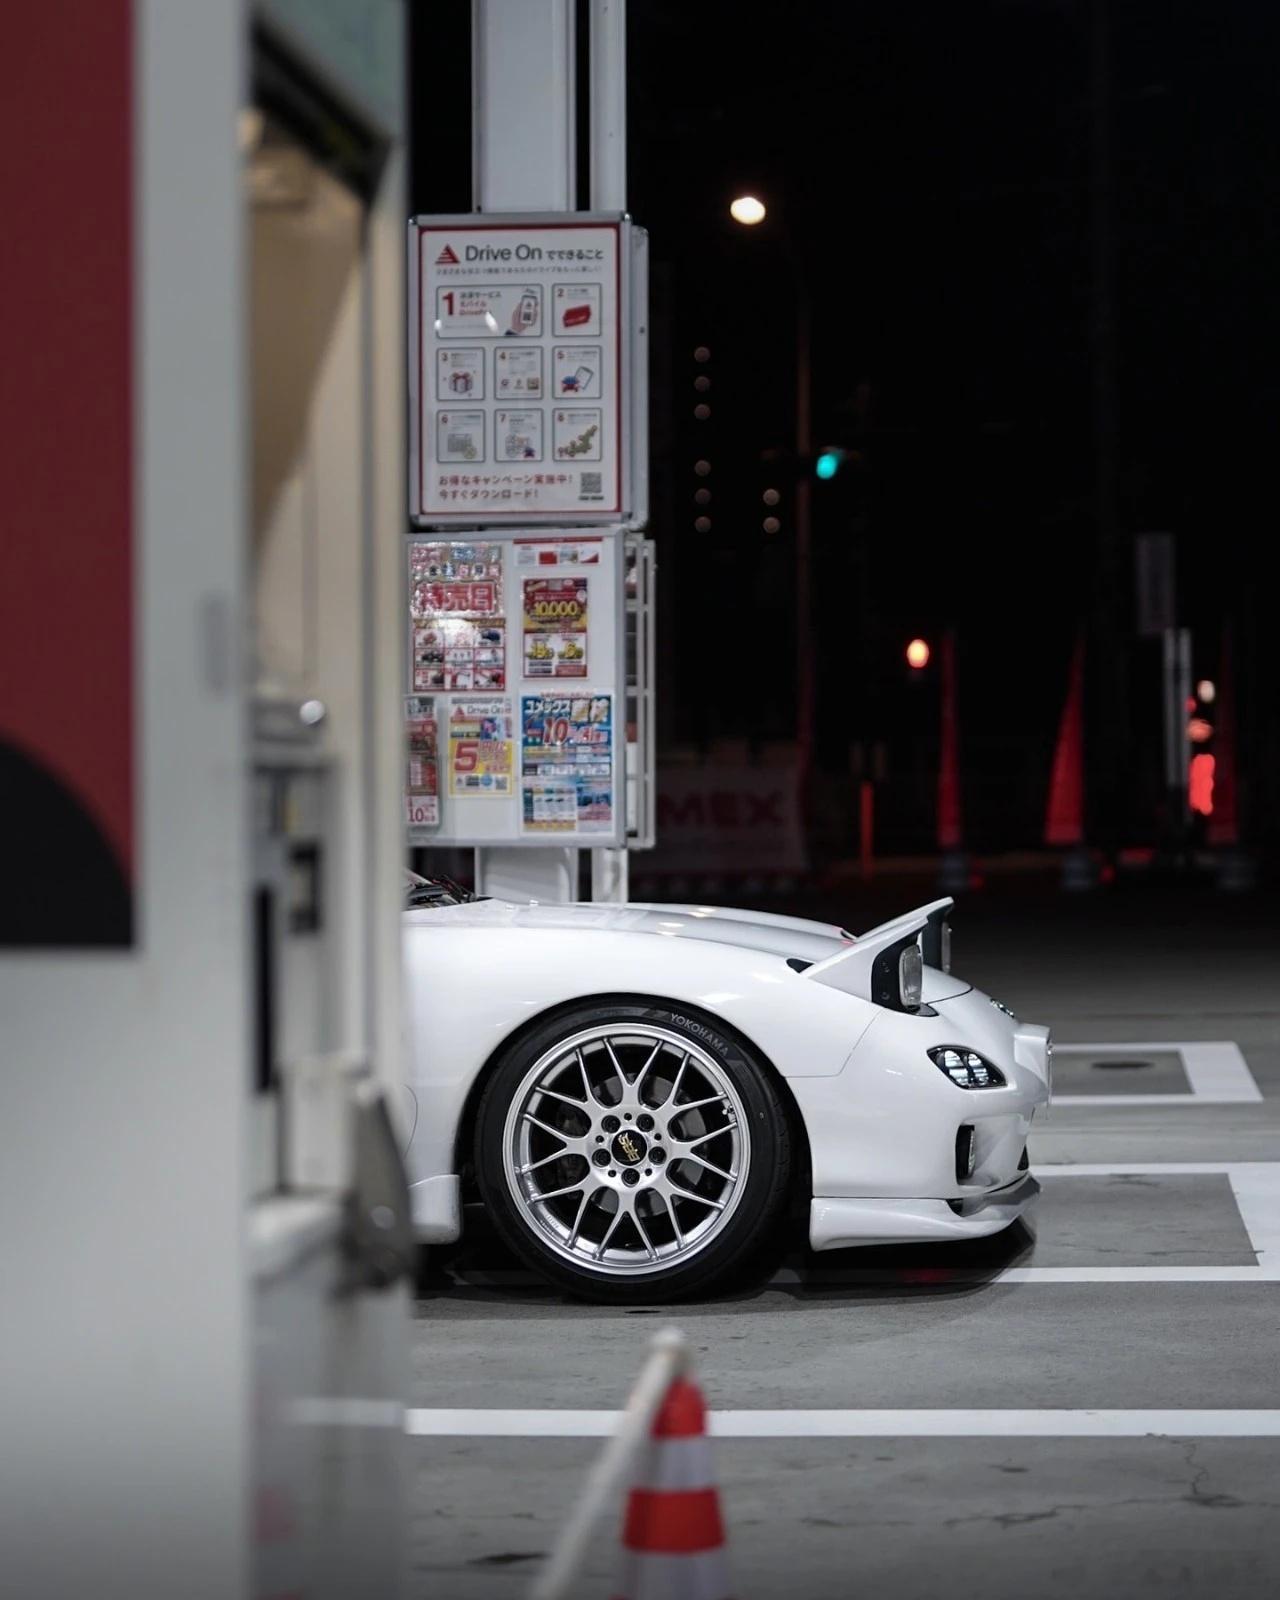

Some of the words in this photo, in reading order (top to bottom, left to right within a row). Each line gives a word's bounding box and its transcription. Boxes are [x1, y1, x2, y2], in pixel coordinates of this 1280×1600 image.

[465, 245, 511, 262] Drive
[515, 244, 542, 261] On
[557, 289, 564, 297] 2
[442, 292, 454, 316] 1
[500, 414, 506, 423] 7
[467, 704, 489, 715] Drive
[543, 717, 570, 745] 10
[454, 741, 479, 772] 5
[408, 807, 424, 822] 10
[671, 1013, 729, 1056] YOKOHAMA
[618, 1132, 640, 1162] BBS
